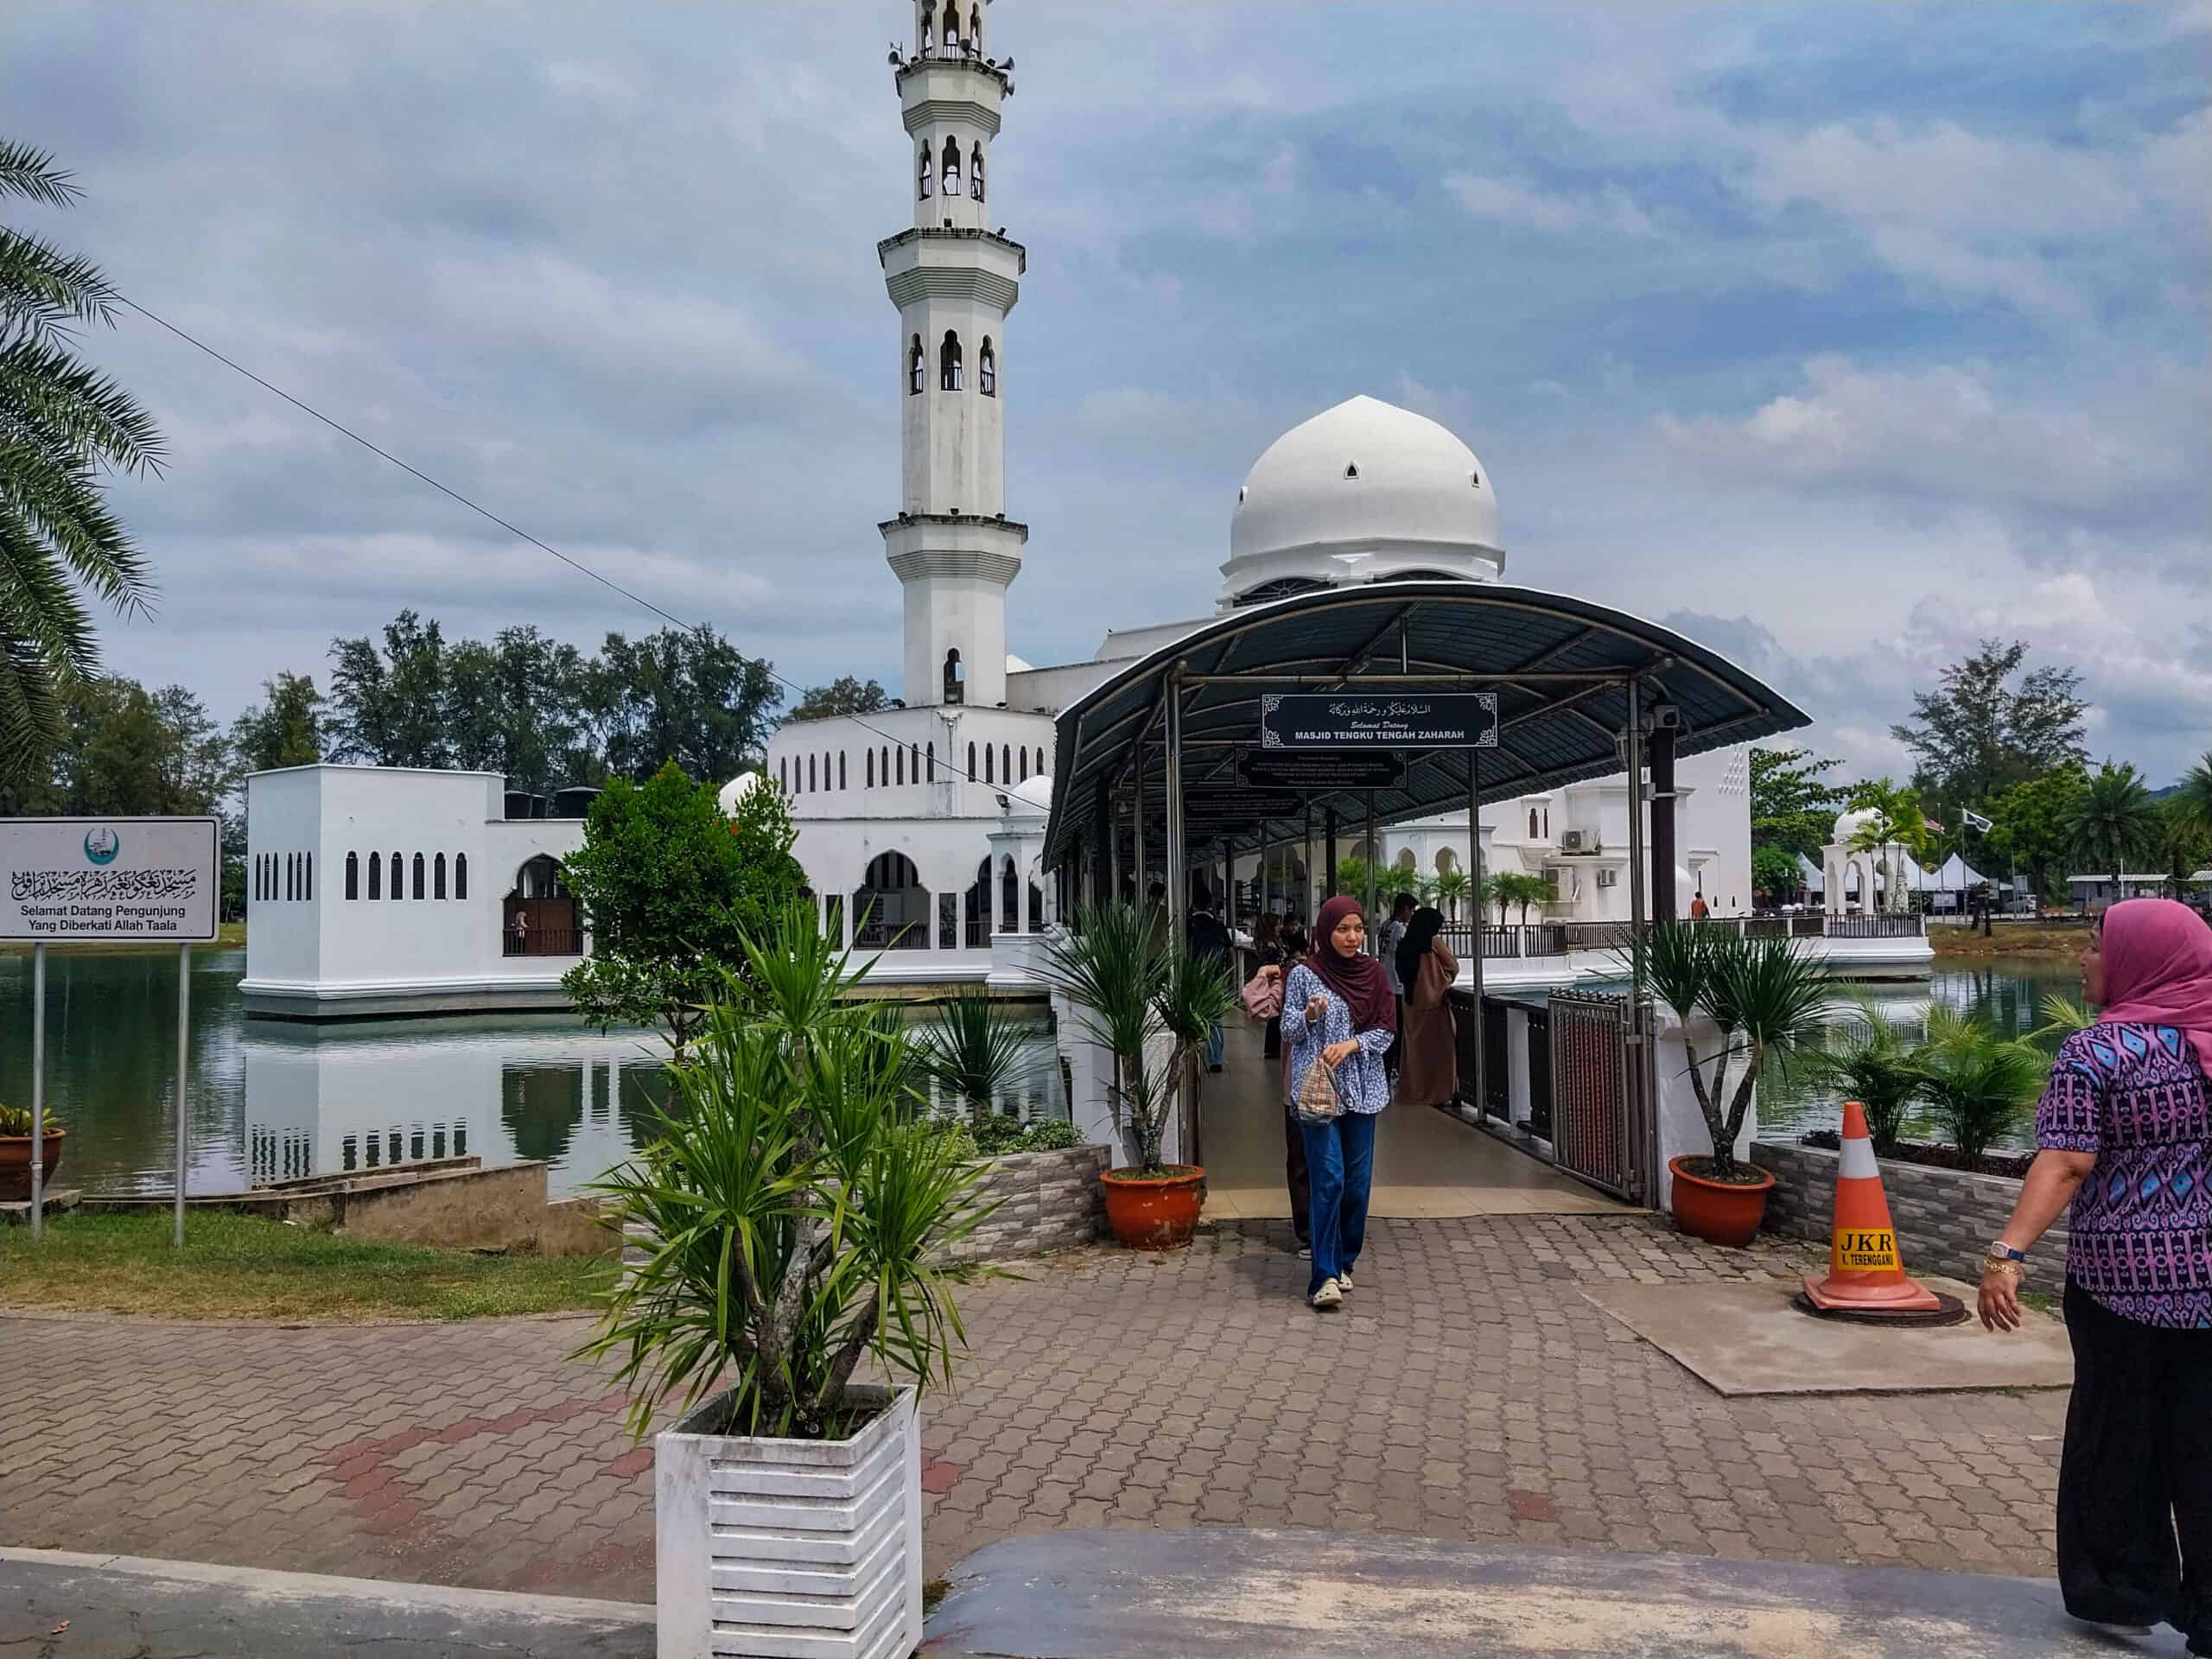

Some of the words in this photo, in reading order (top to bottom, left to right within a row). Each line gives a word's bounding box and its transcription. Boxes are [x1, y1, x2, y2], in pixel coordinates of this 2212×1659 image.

[1351, 721, 1381, 729] Selamat
[1382, 721, 1409, 730] Datang
[1295, 731, 1332, 740] MASJID
[1334, 731, 1374, 740] TENGKU
[1376, 731, 1416, 740] TENGAH
[1417, 731, 1465, 740] ZAHARAH
[21, 905, 67, 916] Selamat
[71, 905, 112, 918] Datang
[116, 905, 186, 918] Pengunjung
[29, 919, 56, 932] Yang
[60, 919, 111, 931] Diberkati
[114, 919, 143, 931] Allah
[146, 919, 177, 931] Taala
[1840, 1233, 1892, 1252] JKR
[1850, 1253, 1894, 1266] TERENGGANU
